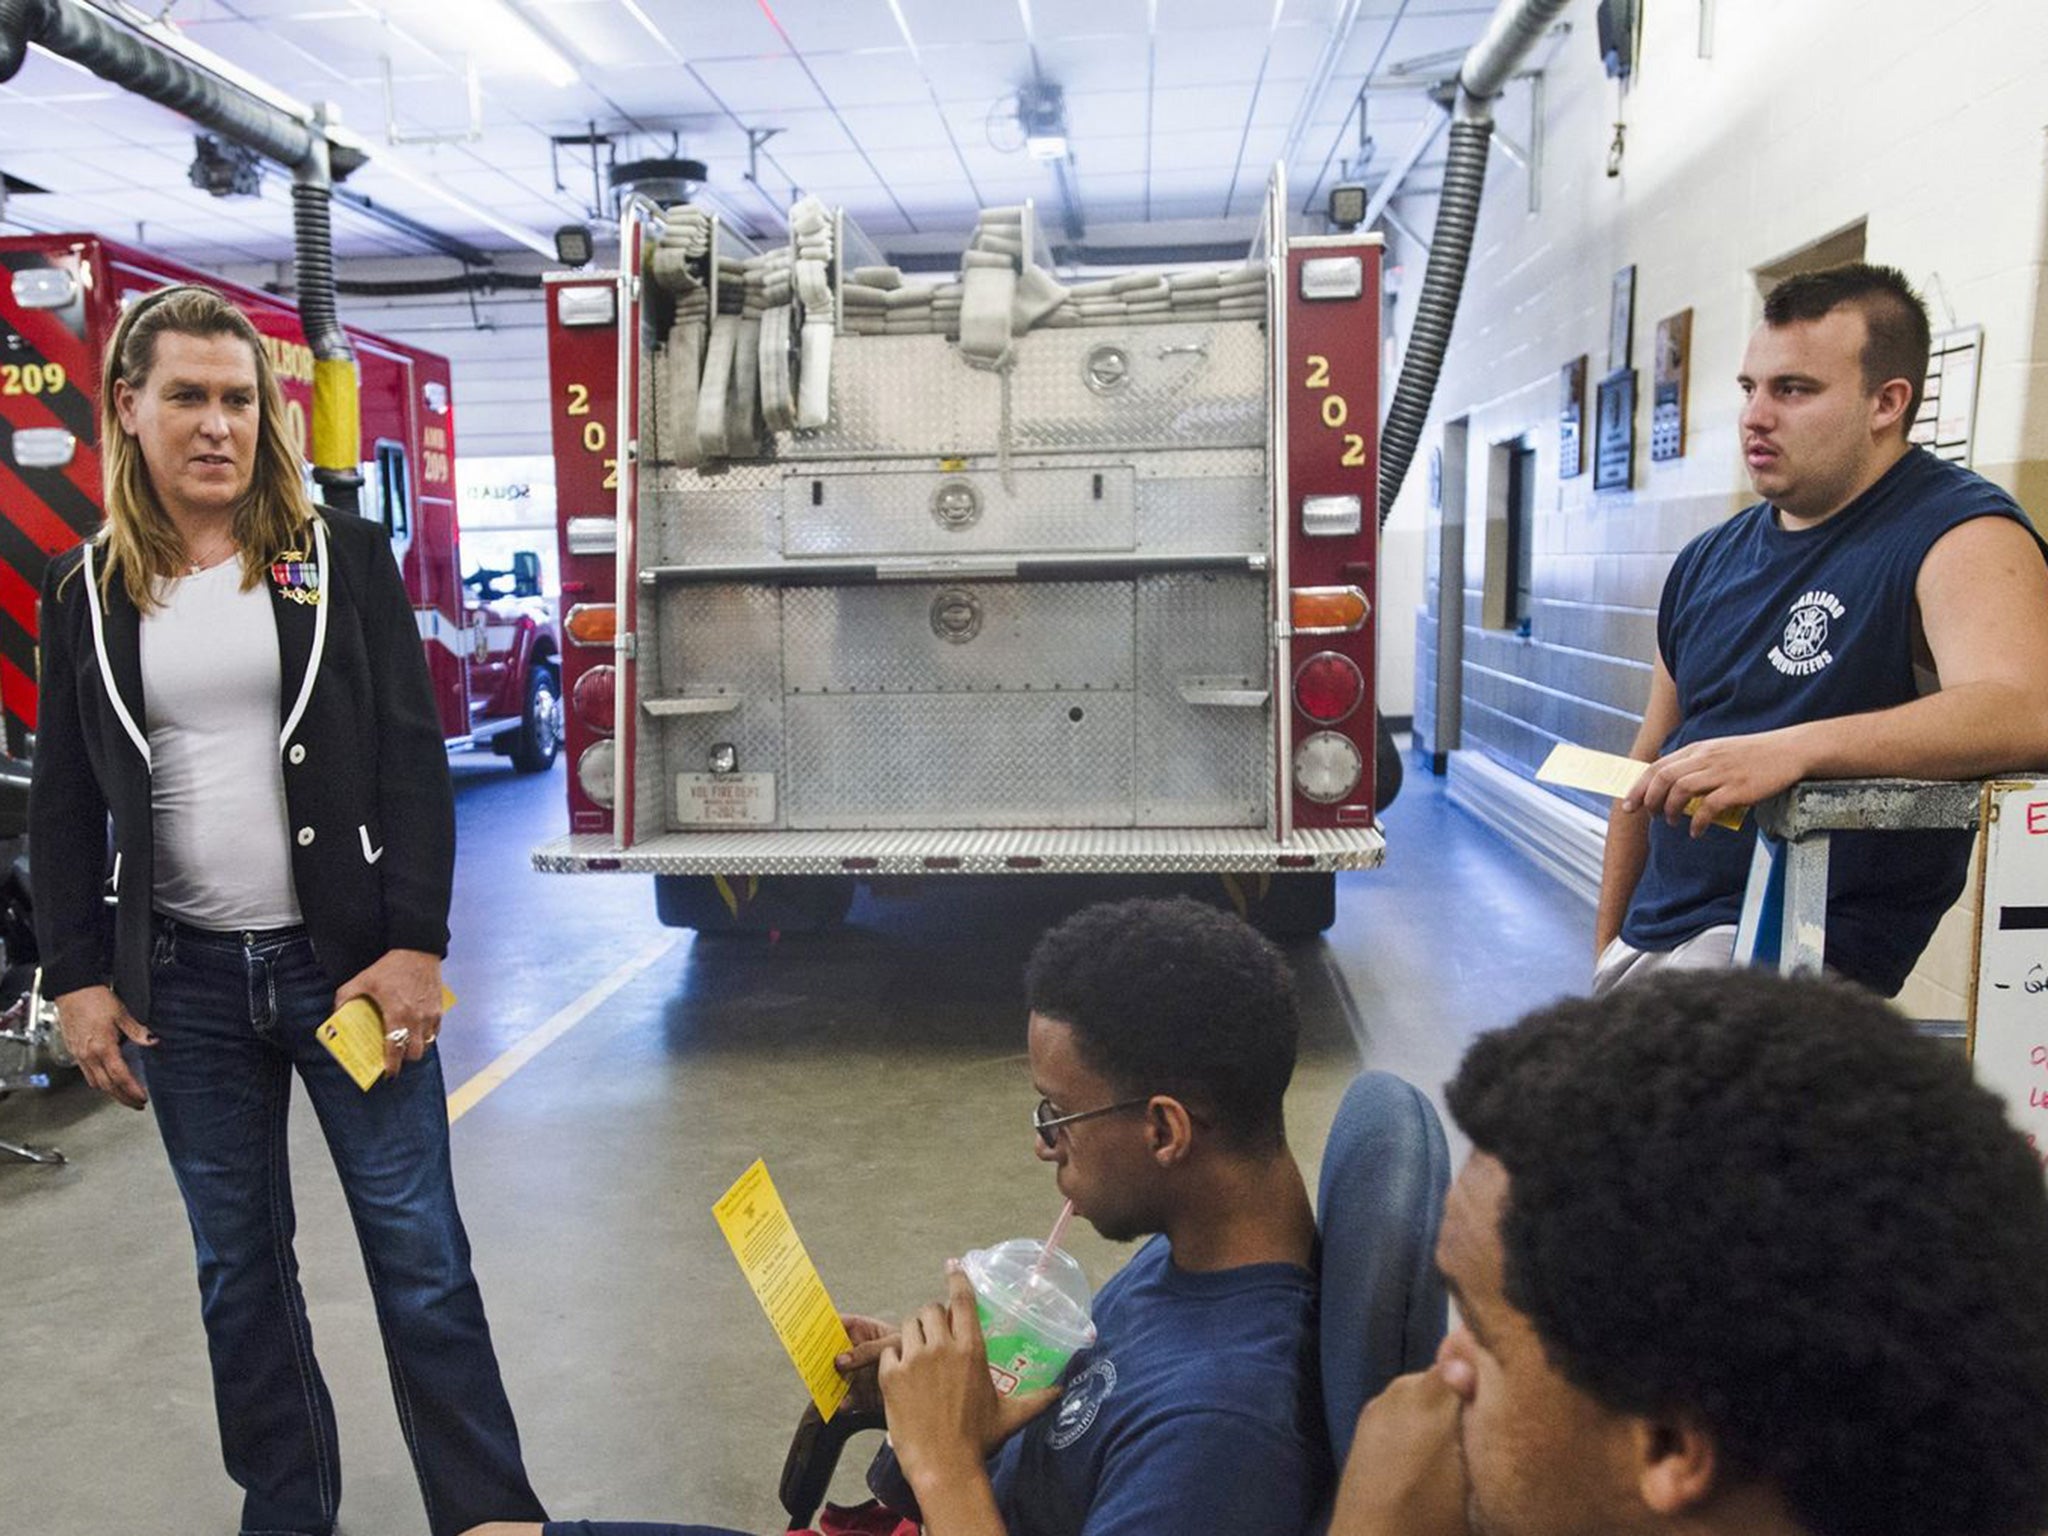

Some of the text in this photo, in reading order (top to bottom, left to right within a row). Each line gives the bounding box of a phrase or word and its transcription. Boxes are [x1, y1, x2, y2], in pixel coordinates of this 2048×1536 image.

[0, 363, 66, 396] 209
[1305, 355, 1366, 467] 202
[422, 450, 449, 482] 209
[1767, 646, 1833, 676] VOLUNTEERS
